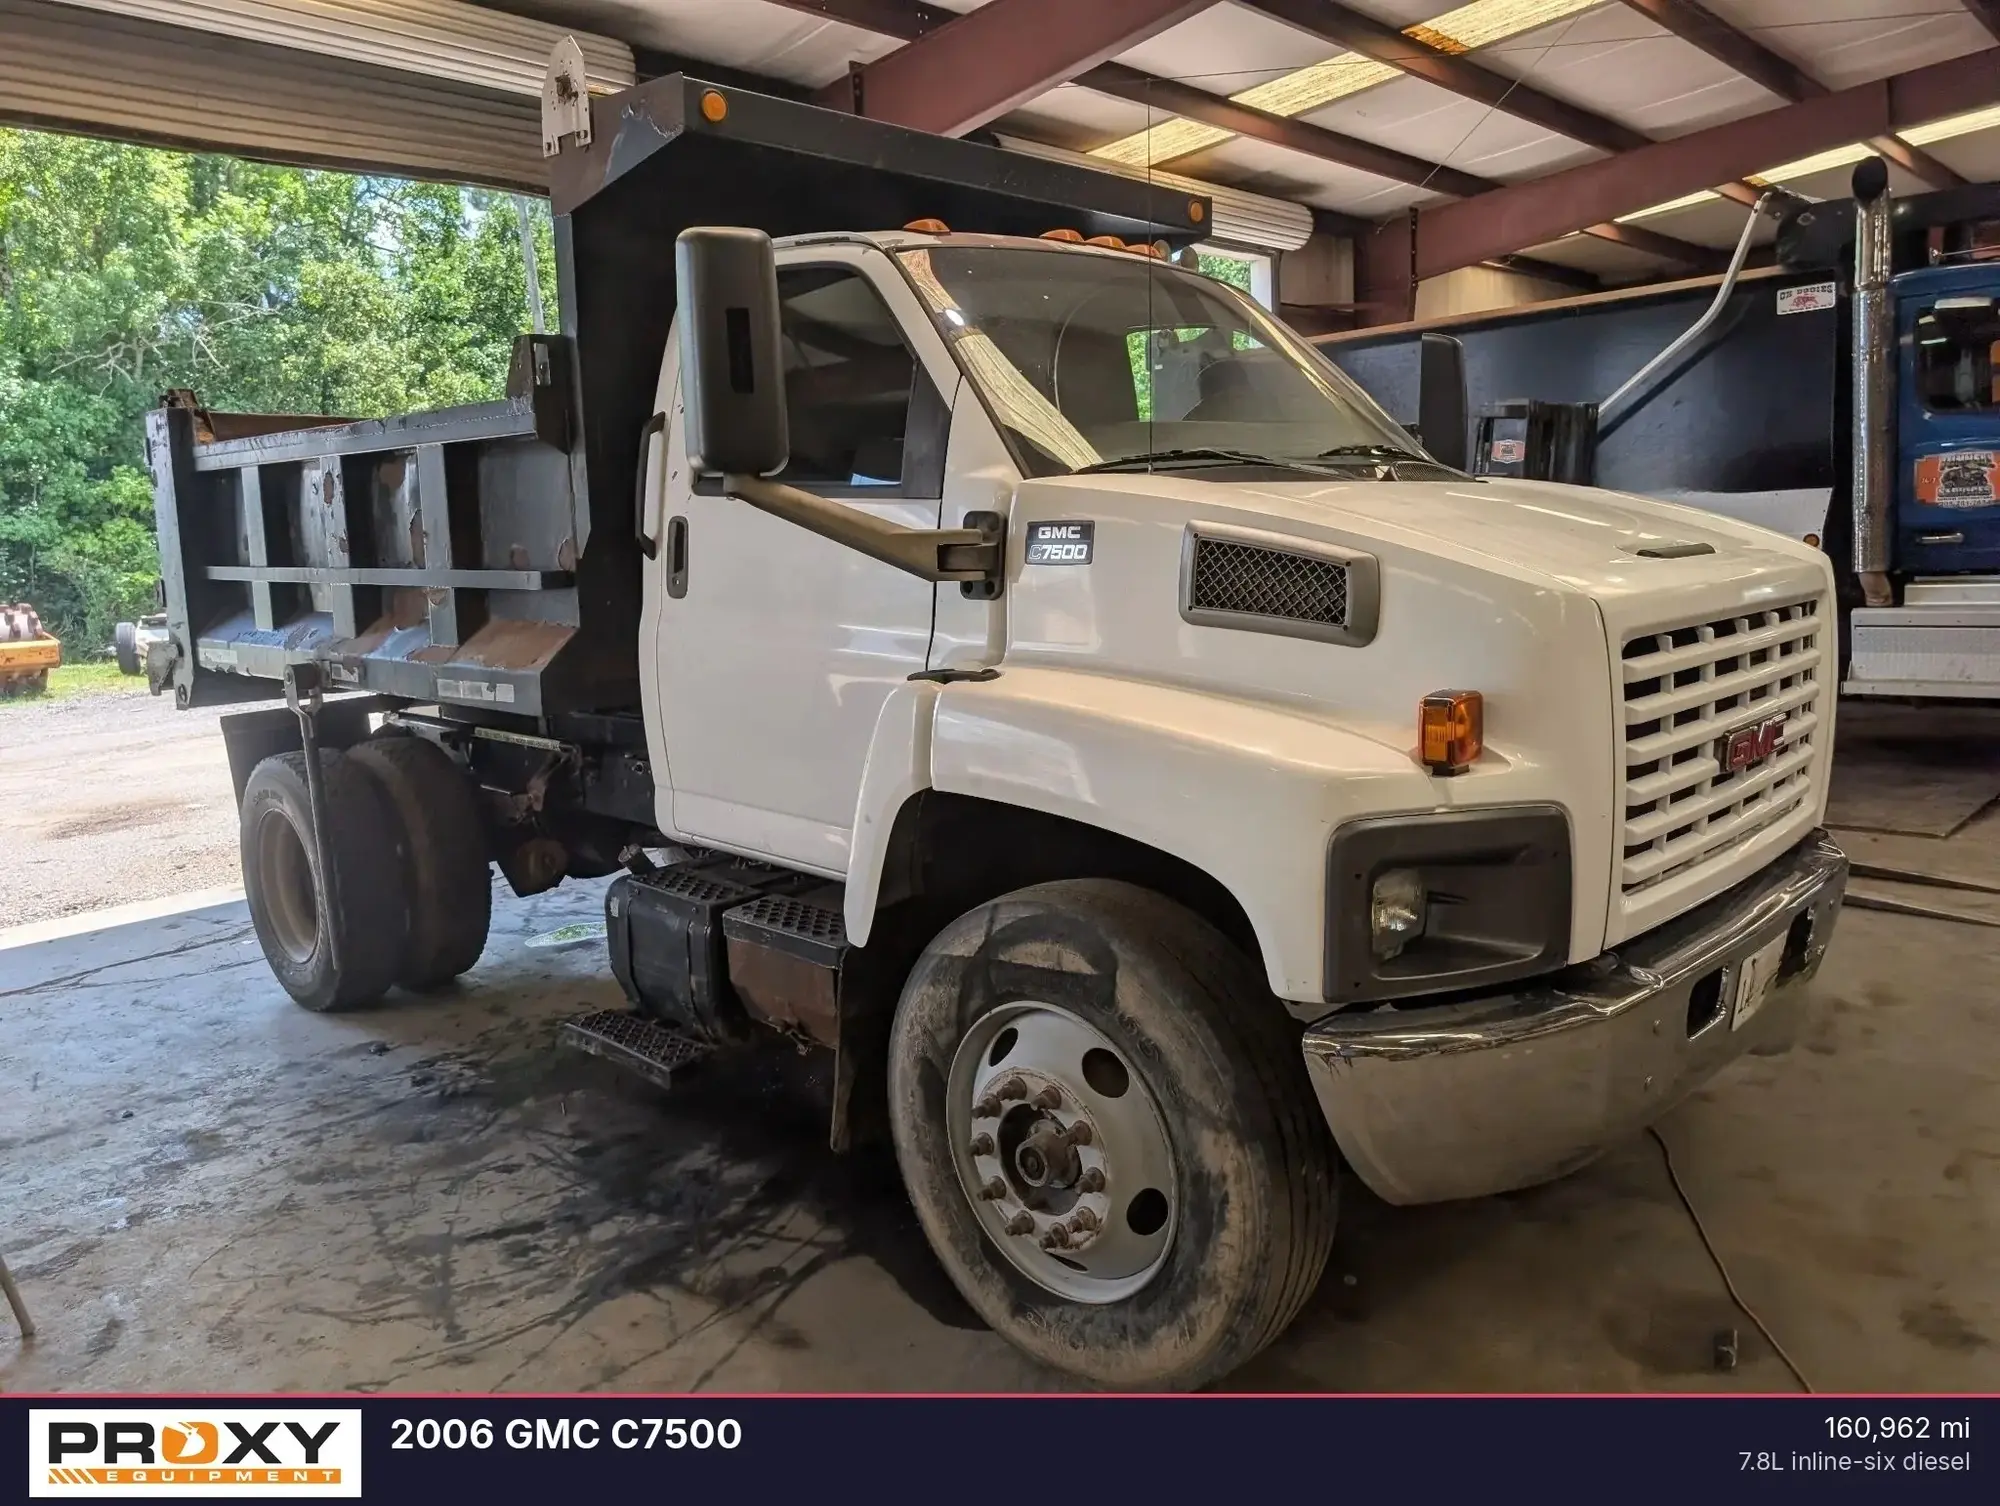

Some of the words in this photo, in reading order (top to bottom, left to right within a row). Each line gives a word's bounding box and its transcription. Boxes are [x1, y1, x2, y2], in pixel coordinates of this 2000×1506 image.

[1796, 285, 1833, 295] BODIES
[1038, 525, 1081, 539] GMC
[1028, 544, 1088, 560] C7500
[1728, 712, 1787, 772] GMC
